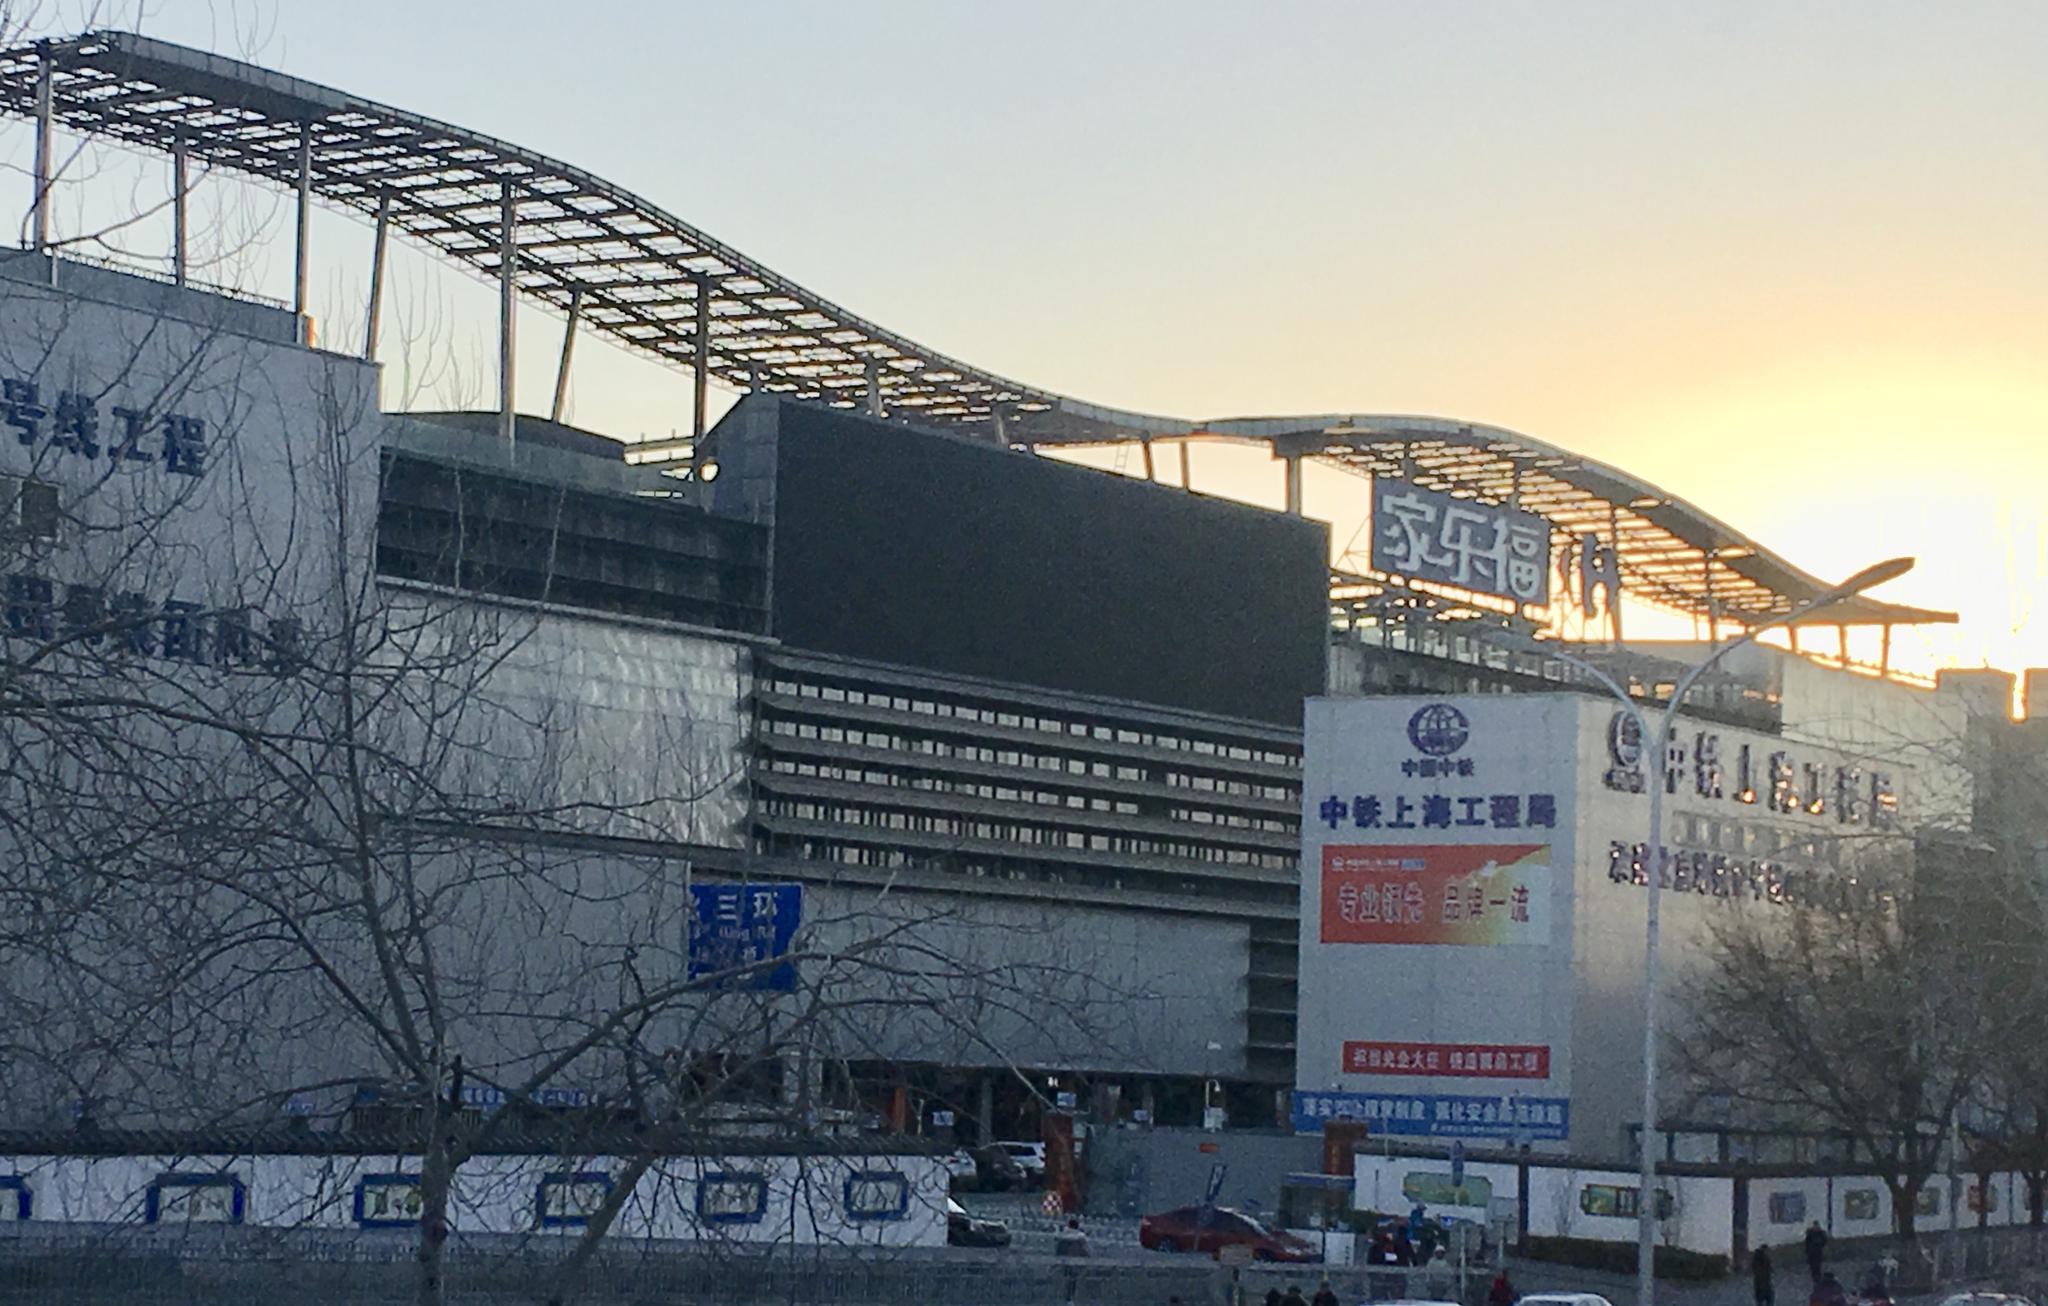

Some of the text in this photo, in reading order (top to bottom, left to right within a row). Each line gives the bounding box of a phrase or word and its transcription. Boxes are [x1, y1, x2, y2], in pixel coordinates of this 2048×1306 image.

[1382, 492, 1541, 598] 家乐福
[1401, 758, 1475, 777] 中国中铁
[1320, 794, 1557, 829] 中铁上海工程局
